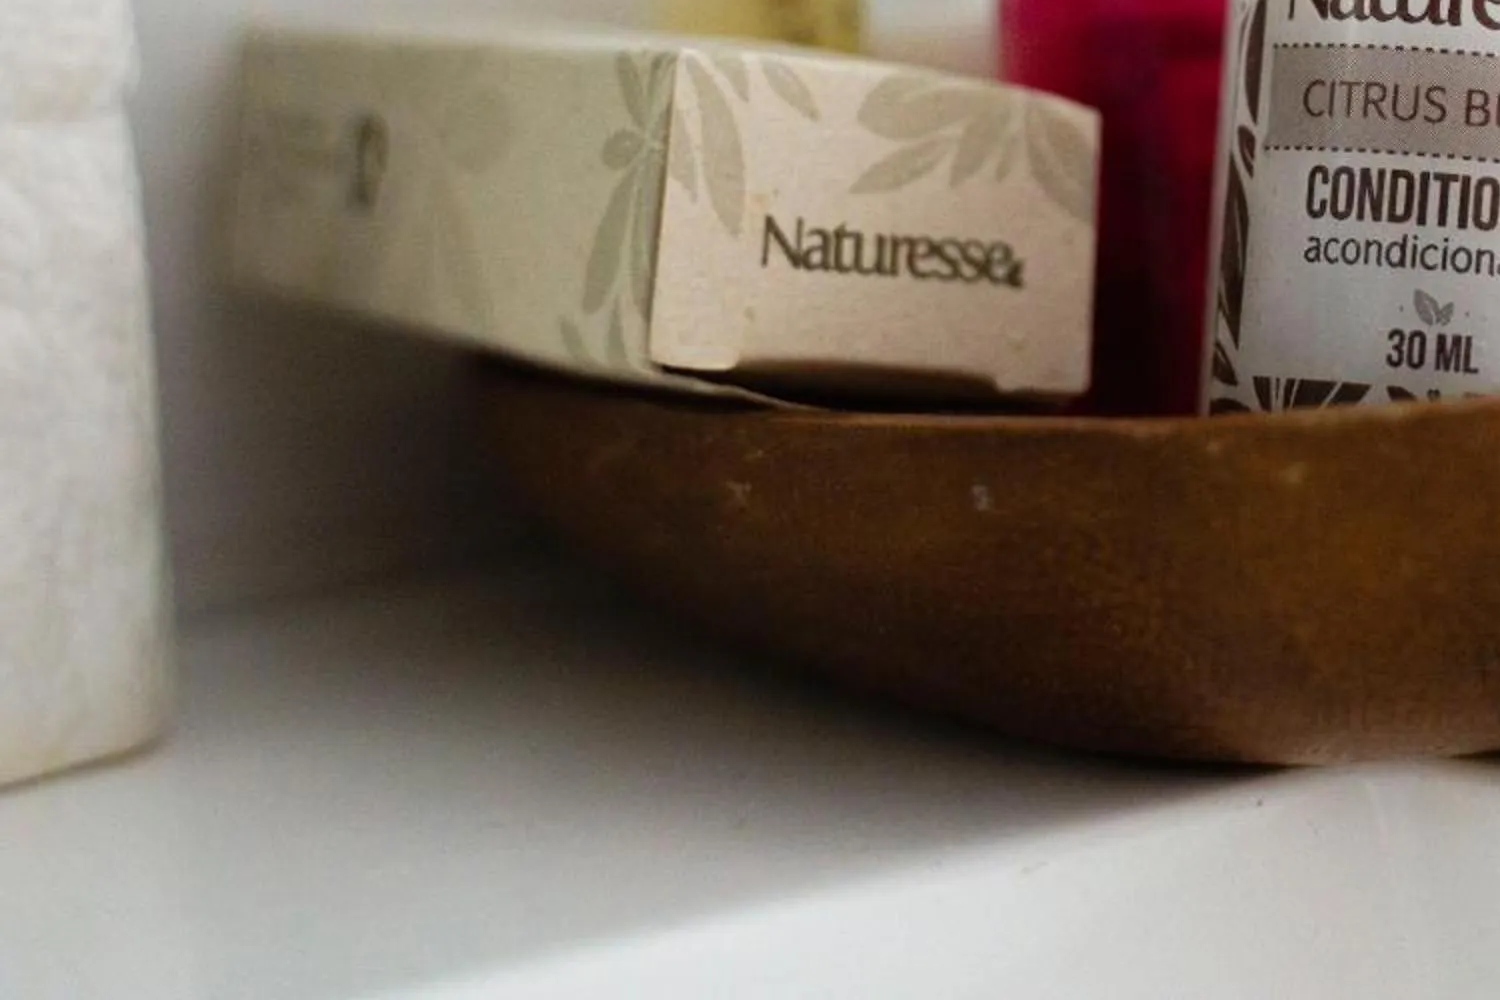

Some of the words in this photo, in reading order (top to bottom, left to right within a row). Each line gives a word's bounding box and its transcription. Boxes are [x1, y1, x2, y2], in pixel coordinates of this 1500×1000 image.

[1302, 78, 1447, 126] CITRUS
[760, 214, 1018, 287] Naturesse
[1386, 329, 1427, 371] 30
[1434, 334, 1480, 375] ML
